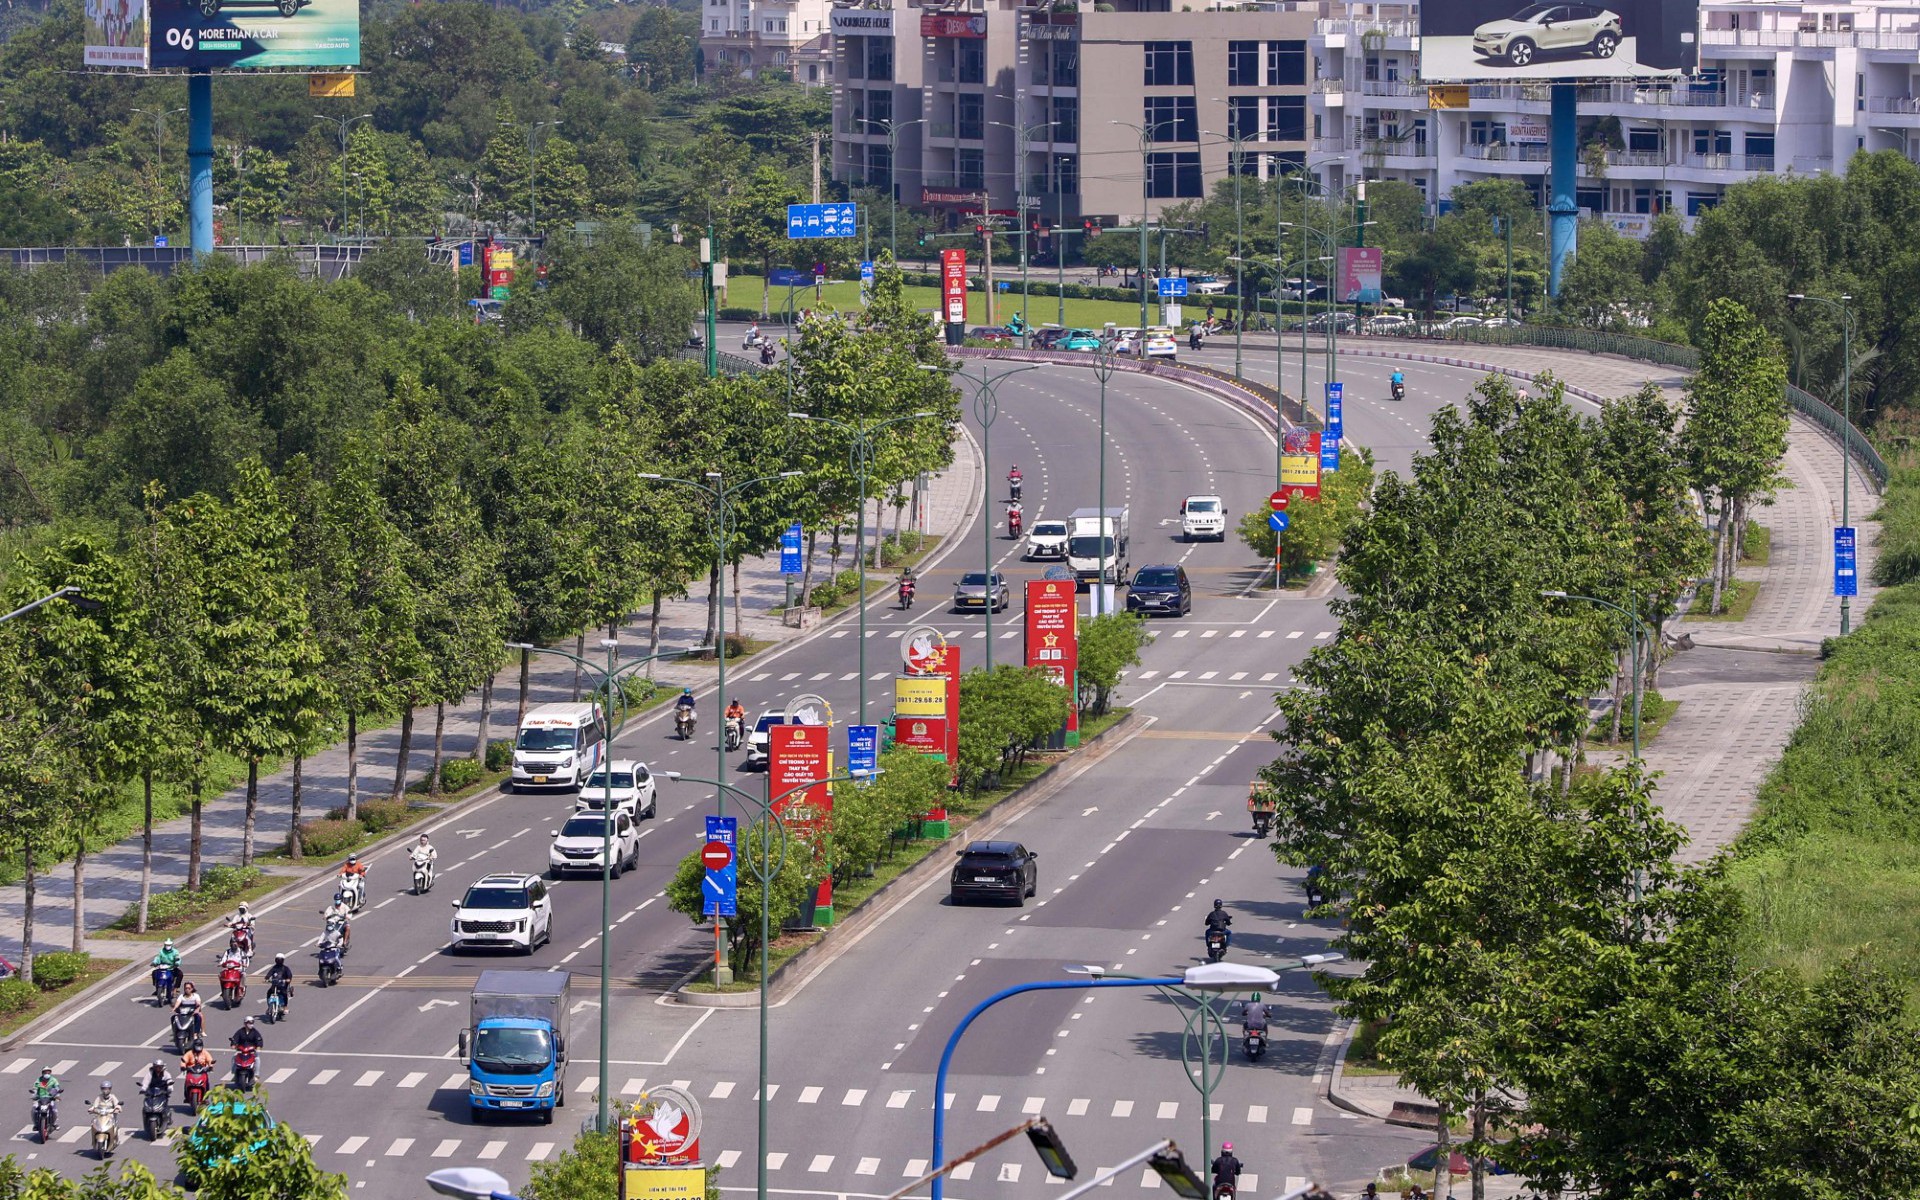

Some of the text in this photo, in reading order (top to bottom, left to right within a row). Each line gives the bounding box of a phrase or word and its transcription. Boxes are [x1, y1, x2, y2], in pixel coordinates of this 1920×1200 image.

[873, 18, 890, 28] HOUSE
[166, 28, 194, 50] 06
[199, 29, 278, 39] MORE THAN A CAR
[723, 832, 731, 840] TẾ
